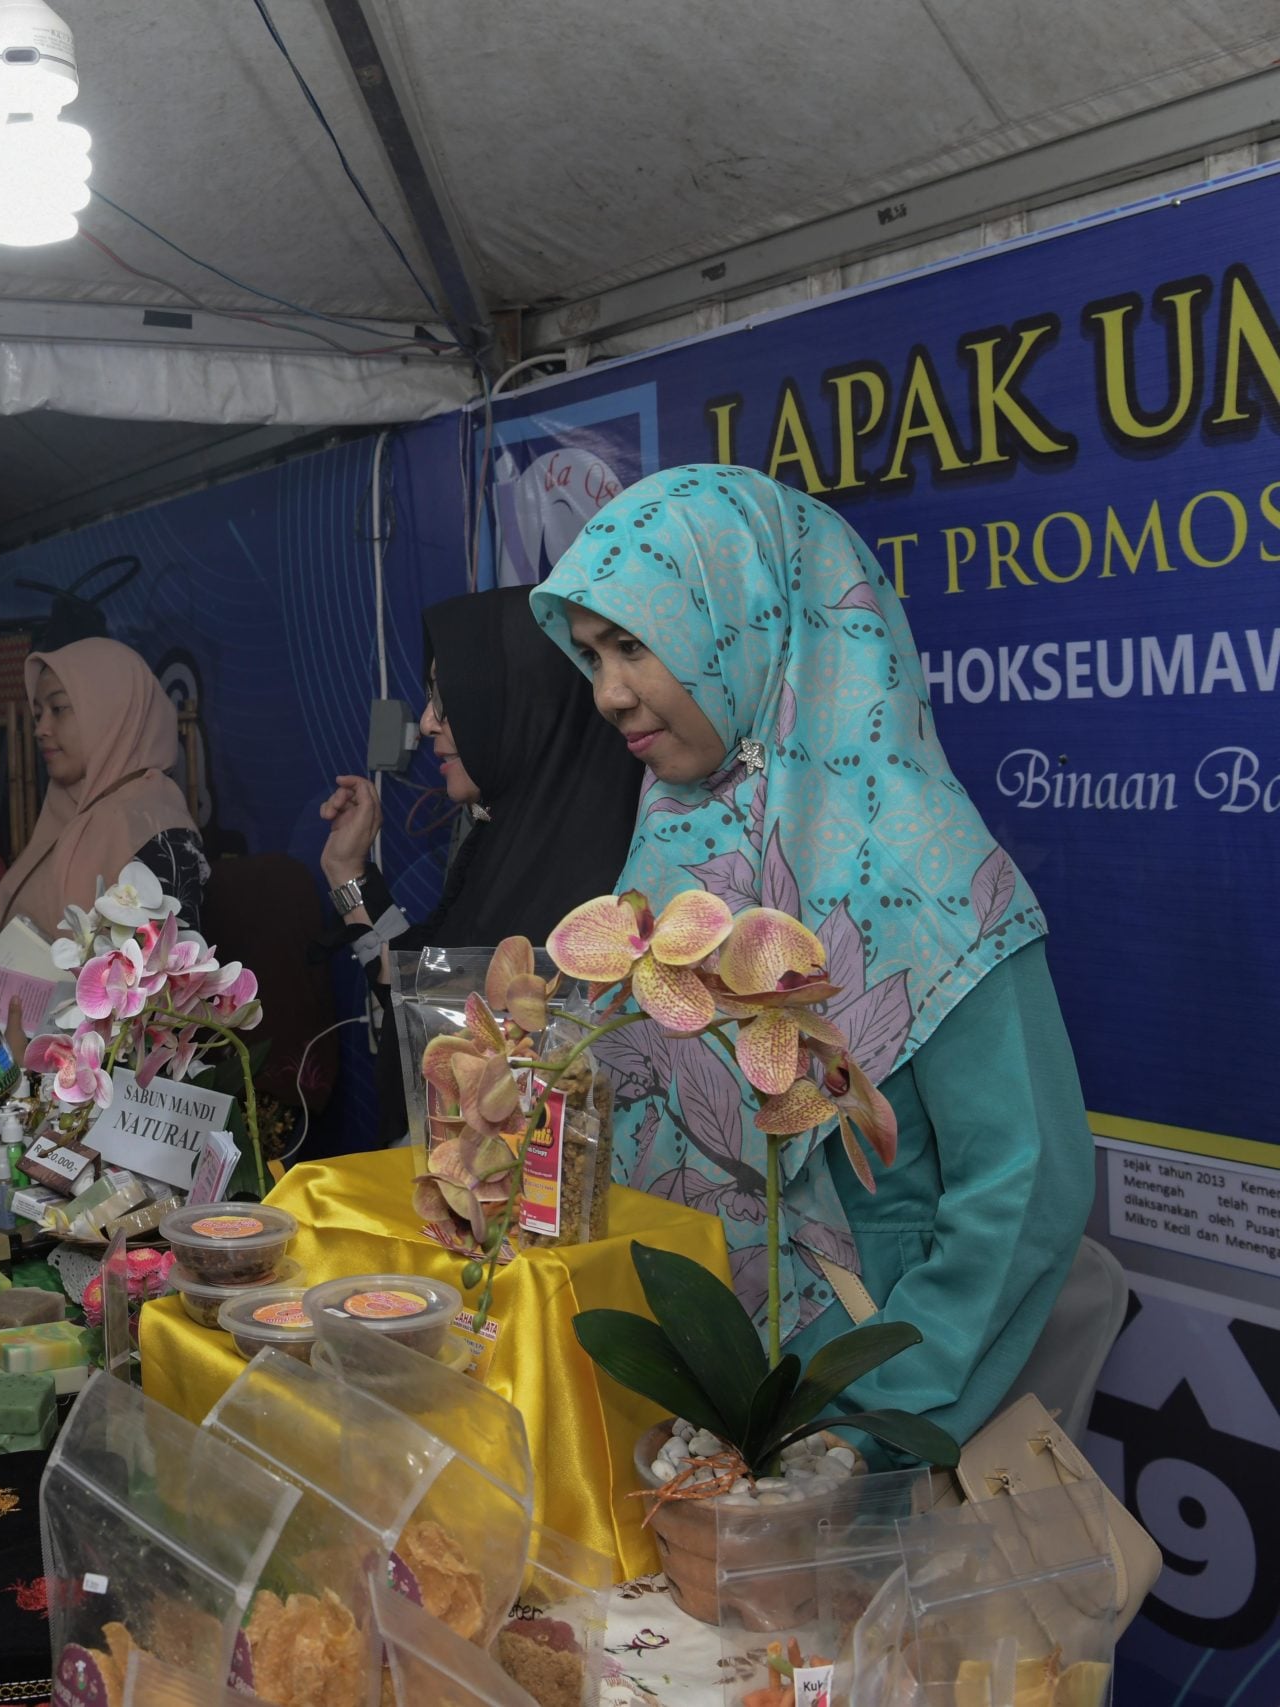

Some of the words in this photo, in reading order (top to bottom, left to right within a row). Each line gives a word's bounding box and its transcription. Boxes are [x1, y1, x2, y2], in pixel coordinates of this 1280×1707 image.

[996, 748, 1178, 810] Binaan
[124, 1085, 168, 1109] SABUN
[169, 1096, 217, 1122] MANDI
[113, 1110, 201, 1153] NATURAL
[1123, 1158, 1152, 1173] sejak
[1158, 1164, 1193, 1181] tahun
[1196, 1171, 1226, 1188] 2013
[1124, 1175, 1185, 1199] Menengah
[1217, 1196, 1249, 1212] telah
[1124, 1194, 1198, 1219] dilaksanakan
[1209, 1213, 1235, 1228] oleh
[1125, 1211, 1158, 1229] Mikro
[1164, 1220, 1191, 1236] Kecil
[1197, 1229, 1219, 1243] dan
